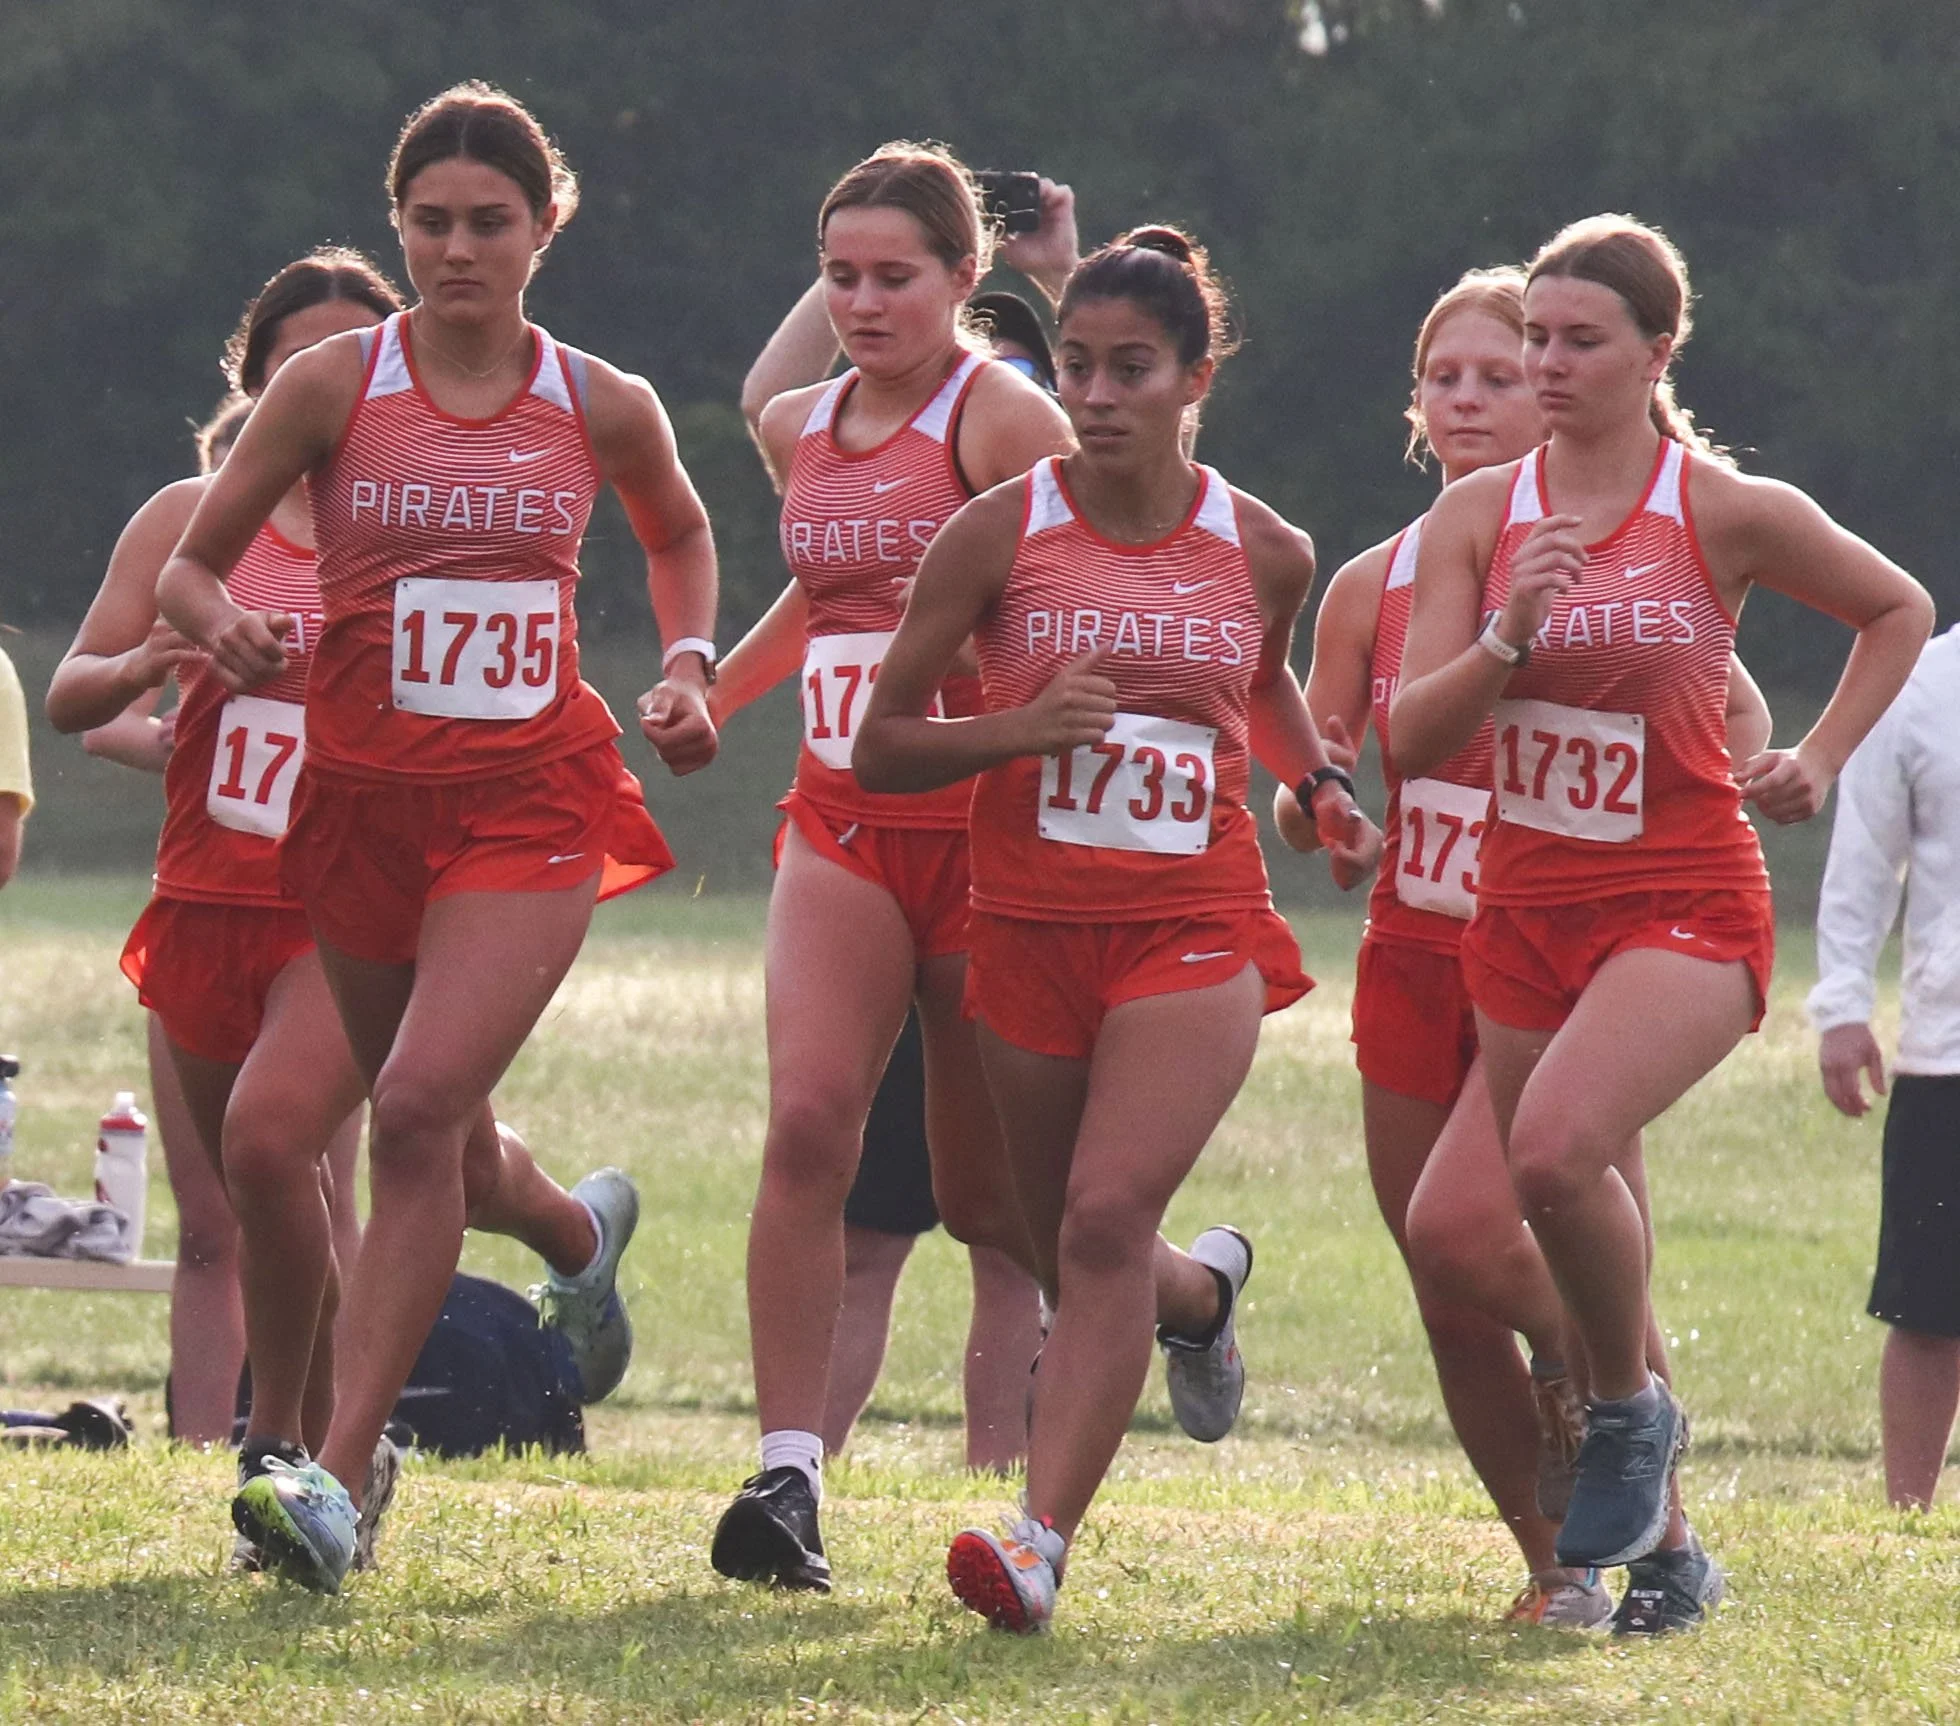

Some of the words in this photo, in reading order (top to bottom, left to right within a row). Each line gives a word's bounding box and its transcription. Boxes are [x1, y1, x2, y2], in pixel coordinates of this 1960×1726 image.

[352, 480, 577, 535] PIRATES
[400, 610, 555, 688] 1735
[1027, 609, 1243, 665] PIRATES
[808, 663, 881, 739] 17
[1047, 742, 1207, 823] 1733
[1501, 724, 1638, 815] 1732
